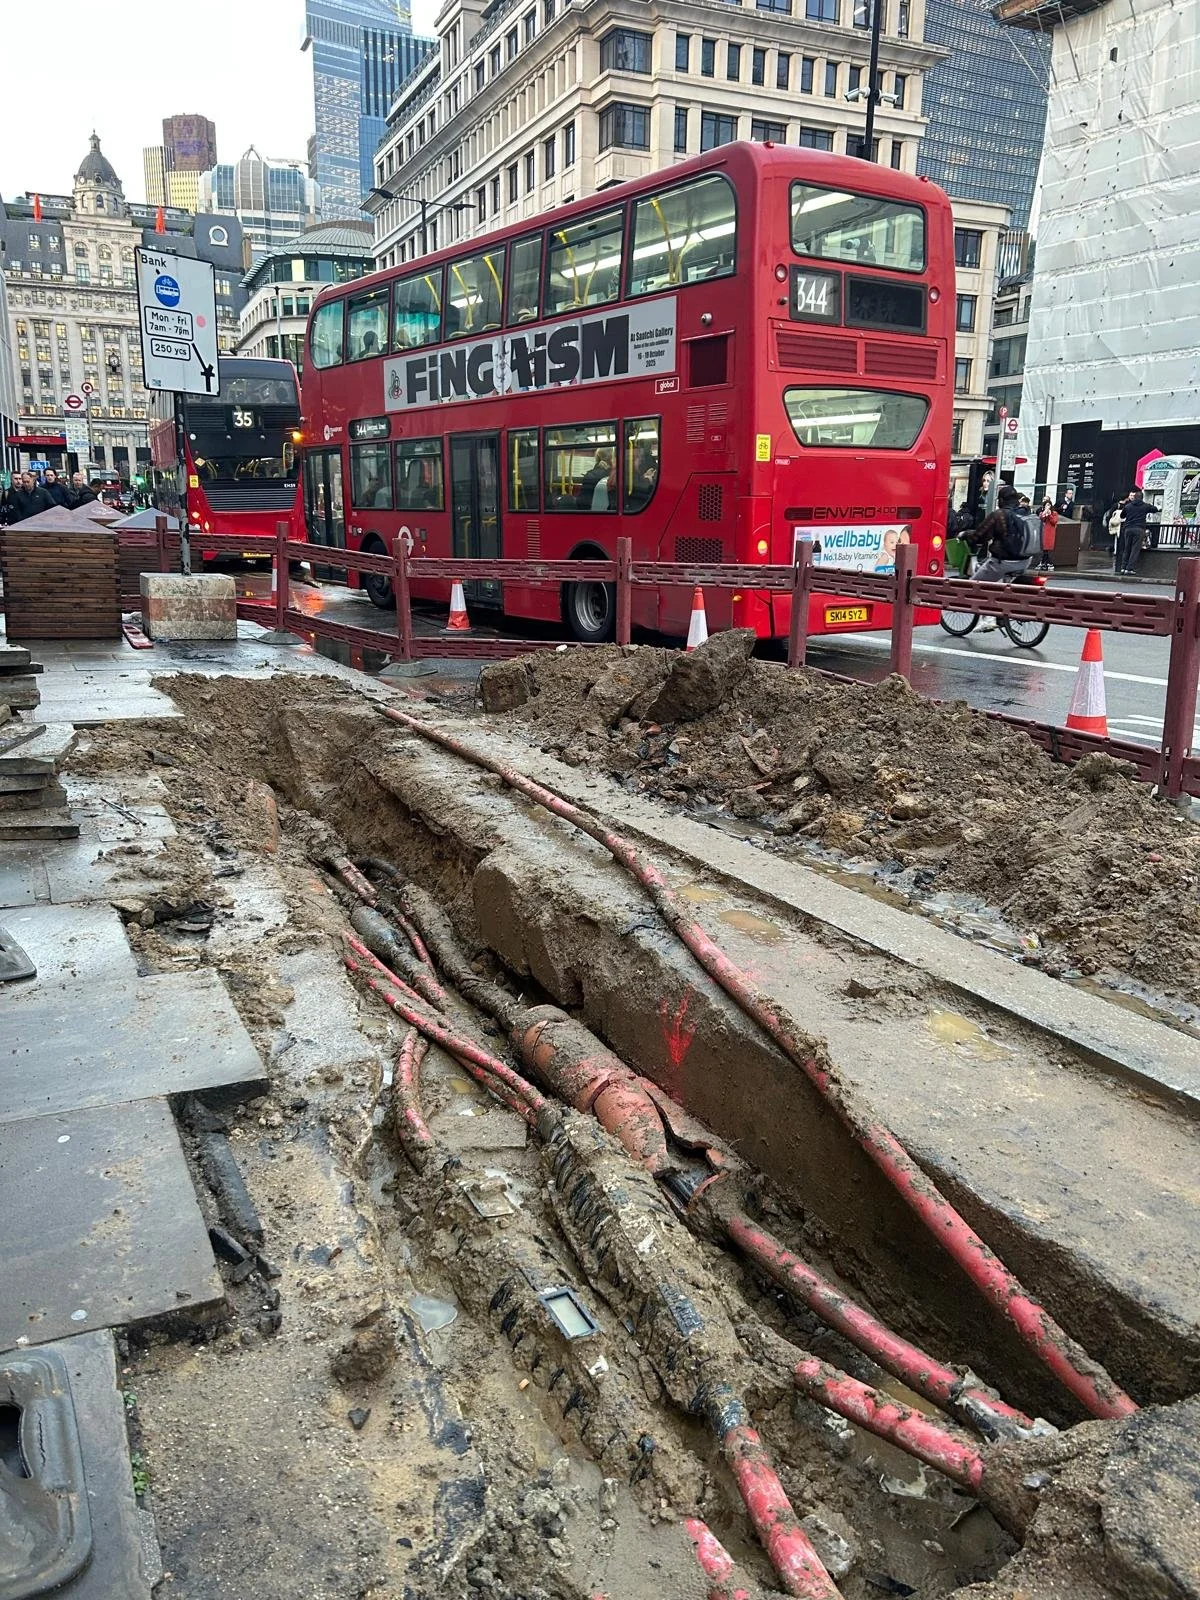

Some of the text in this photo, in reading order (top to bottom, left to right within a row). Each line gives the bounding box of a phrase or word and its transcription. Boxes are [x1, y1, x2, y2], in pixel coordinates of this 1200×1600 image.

[141, 254, 167, 268] Bank
[797, 276, 828, 314] 344
[151, 312, 169, 322] Mon
[177, 316, 187, 325] Fri
[149, 321, 166, 332] 7am
[174, 325, 190, 335] 7pm
[655, 327, 674, 338] Gallery
[155, 343, 172, 353] 250
[660, 380, 675, 392] global
[233, 411, 252, 427] 35
[824, 530, 882, 551] wellbaby
[838, 552, 853, 561] Baby
[853, 551, 878, 560] Vitamins
[830, 610, 863, 621] SK14 SYZ
